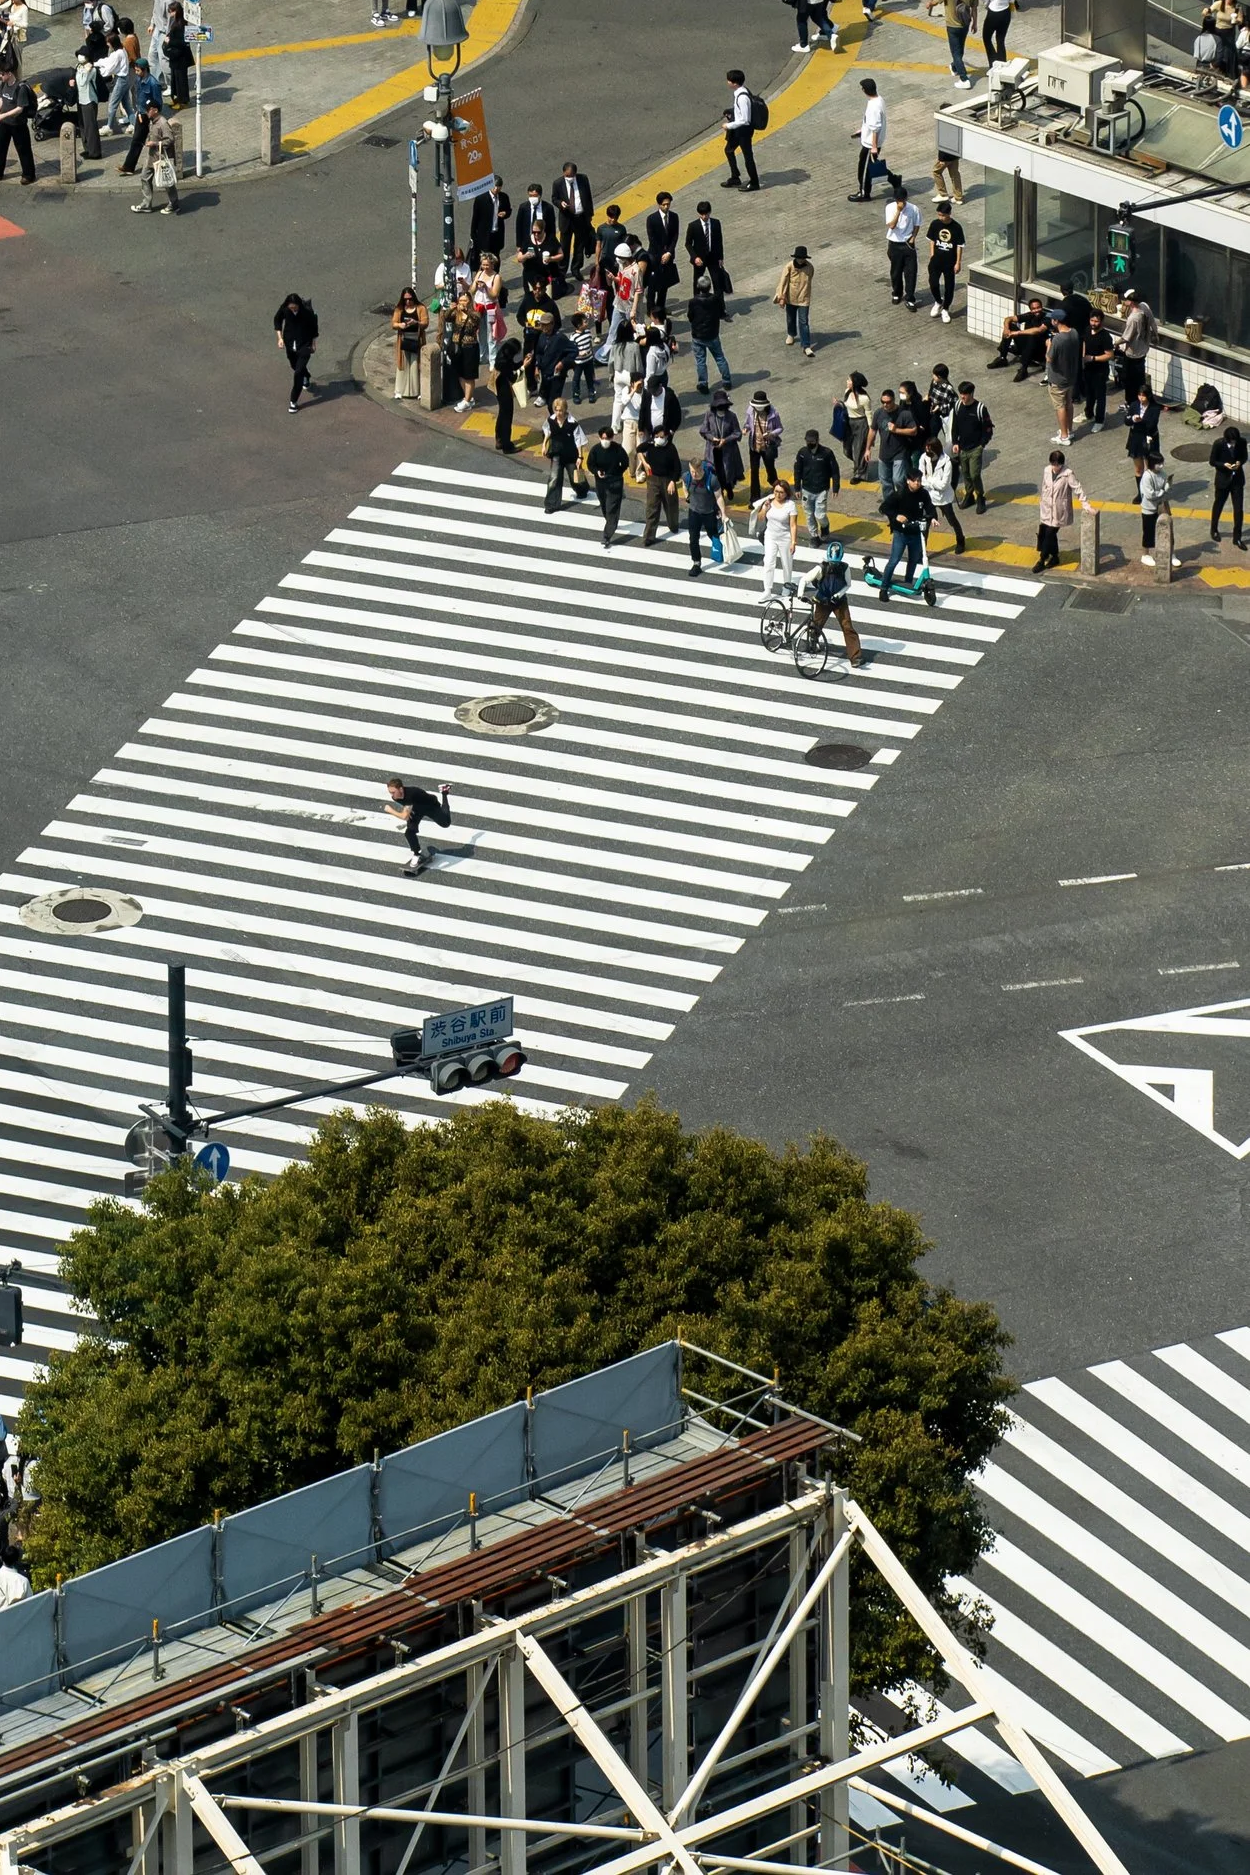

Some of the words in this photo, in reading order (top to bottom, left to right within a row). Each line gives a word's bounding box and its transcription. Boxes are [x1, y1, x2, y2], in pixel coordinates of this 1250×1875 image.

[430, 1005, 506, 1039] 渋谷駅前
[442, 1031, 477, 1048] Shibuya
[479, 1028, 498, 1039] Sta.
